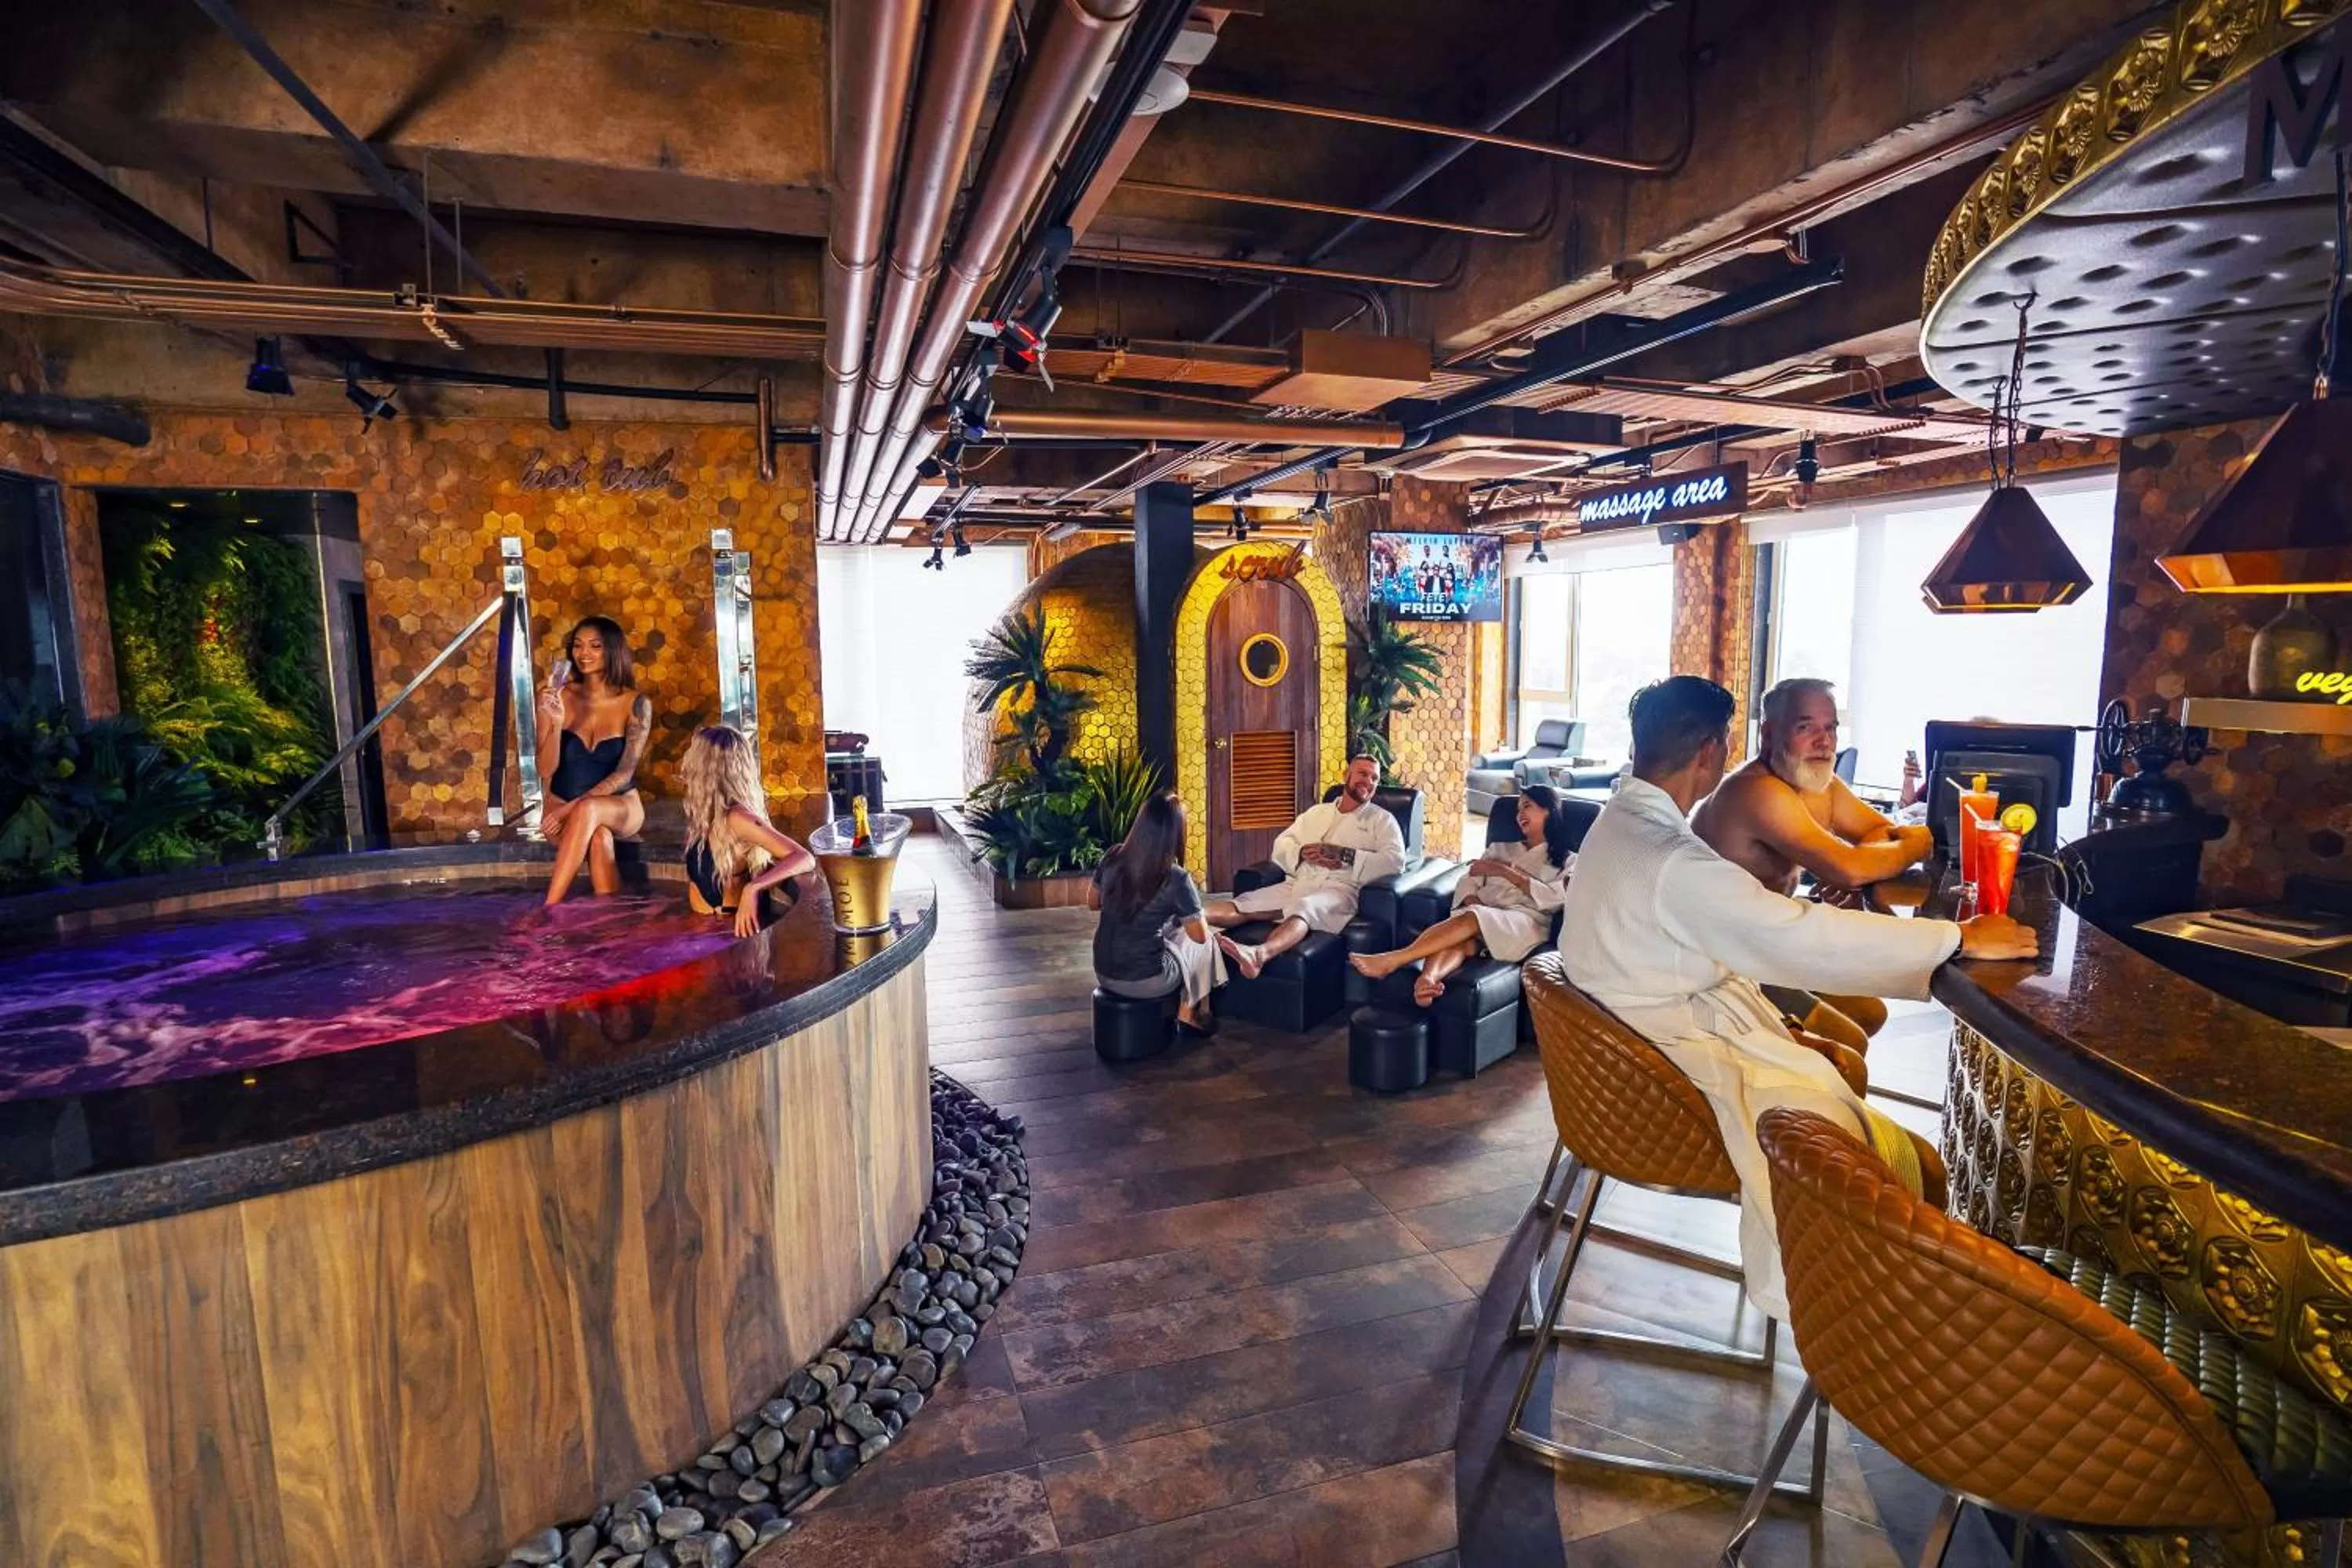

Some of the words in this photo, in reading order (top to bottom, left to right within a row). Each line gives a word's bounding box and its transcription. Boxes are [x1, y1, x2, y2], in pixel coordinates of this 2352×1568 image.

[521, 448, 589, 491] hot
[601, 448, 674, 492] tub
[1580, 486, 1666, 524] massage
[1671, 476, 1727, 507] area
[1399, 602, 1472, 615] FRIDAY
